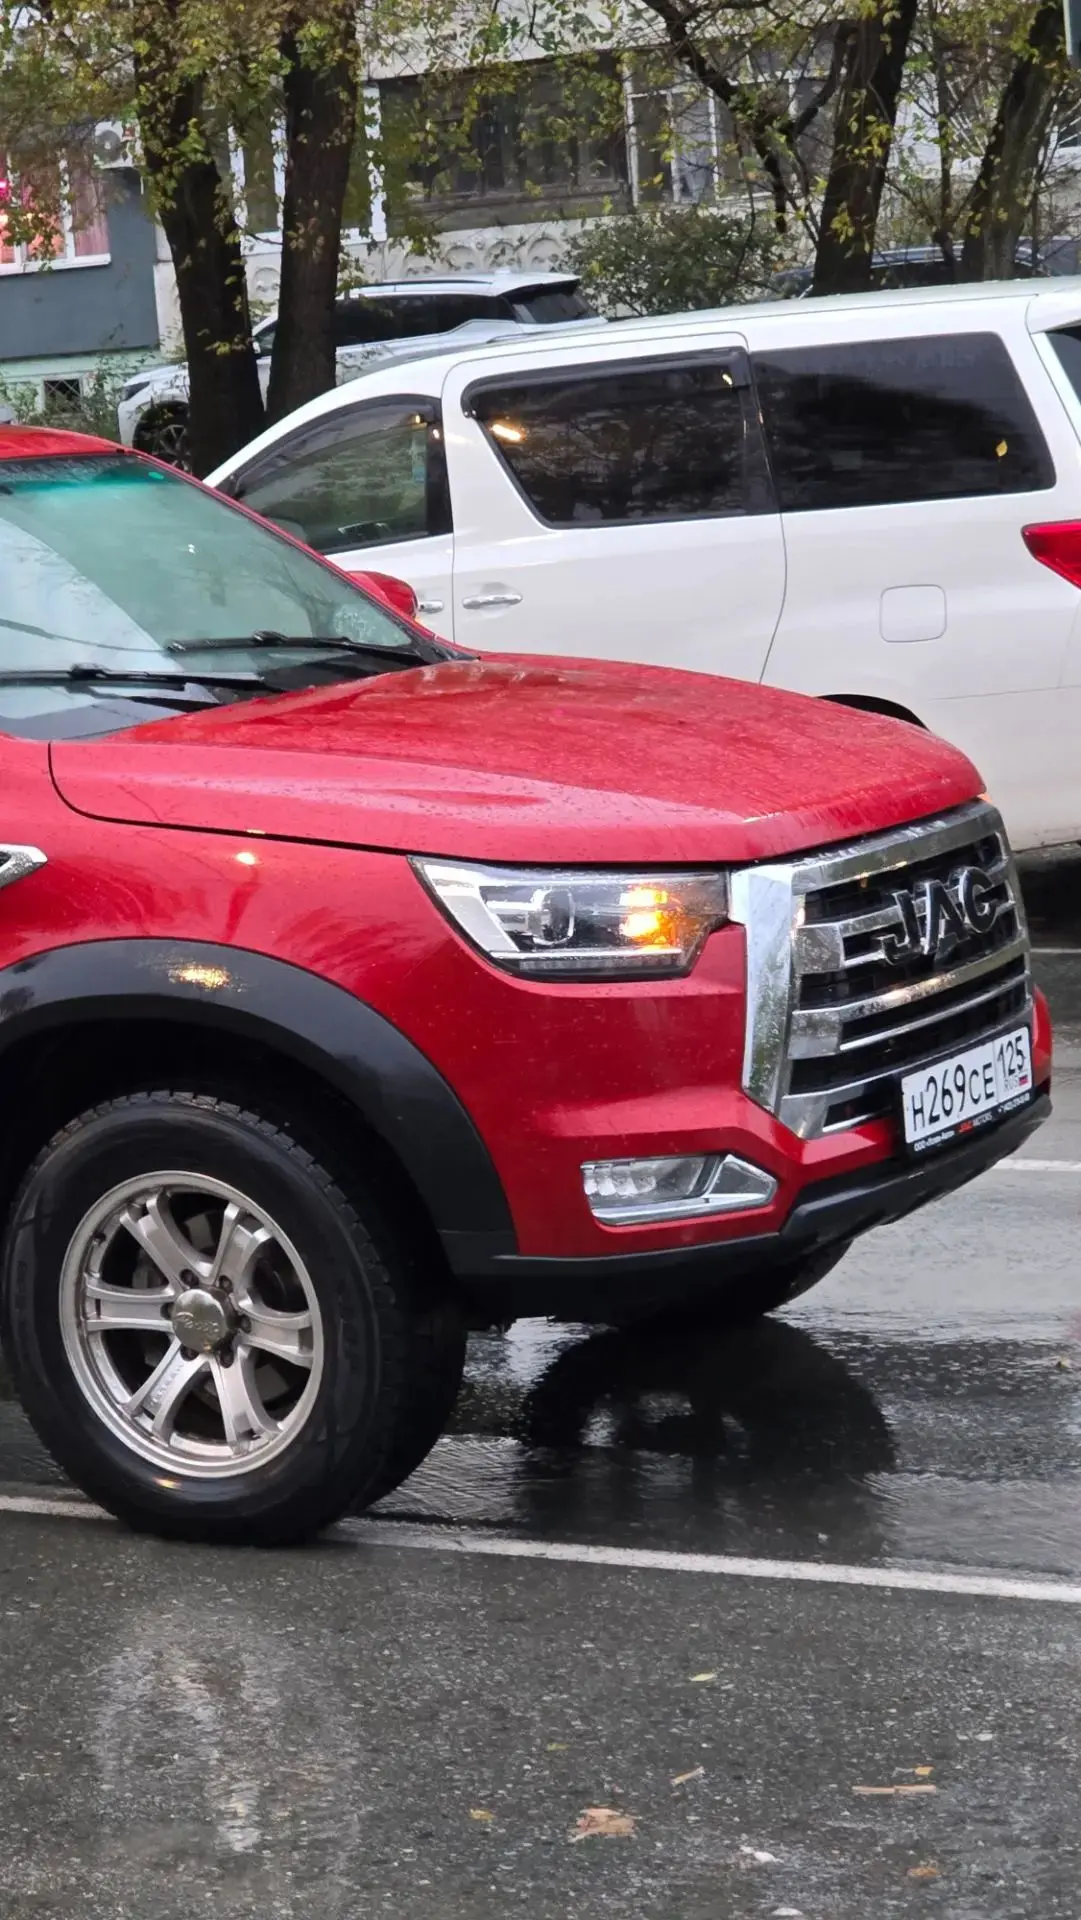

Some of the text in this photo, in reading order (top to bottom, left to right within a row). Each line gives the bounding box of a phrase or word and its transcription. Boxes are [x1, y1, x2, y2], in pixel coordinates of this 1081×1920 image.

[877, 866, 1001, 965] JAC
[911, 1035, 1026, 1132] Н269СЕ 125
